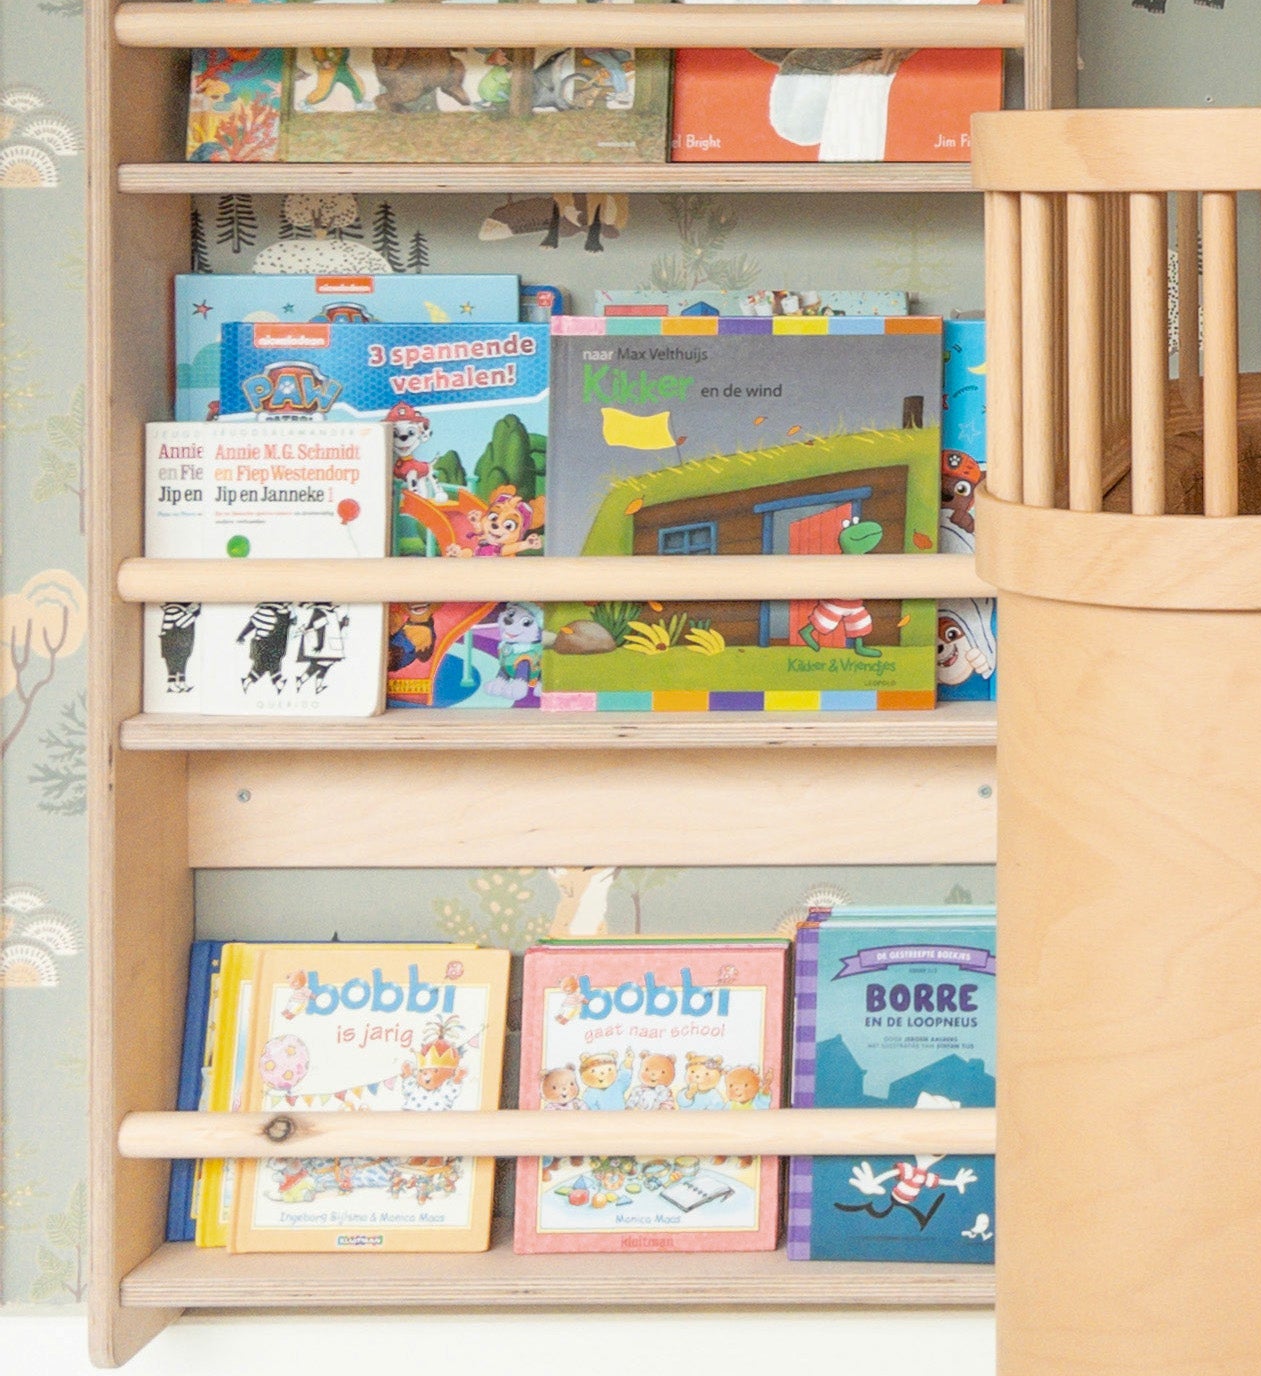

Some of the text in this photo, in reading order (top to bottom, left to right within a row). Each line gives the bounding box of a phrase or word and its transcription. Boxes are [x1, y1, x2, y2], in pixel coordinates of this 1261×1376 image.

[686, 134, 721, 151] Bright
[934, 134, 957, 149] Jim
[369, 333, 535, 367] 3 spannende
[582, 347, 708, 363] naar Max Velthuijs
[391, 364, 516, 392] verhalen!
[582, 363, 782, 405] Kikker en de wind
[242, 374, 343, 413] PAW
[158, 443, 203, 459] Annie
[214, 443, 260, 460] Annie
[297, 443, 361, 460] Schmidt
[158, 467, 177, 481] en
[214, 465, 361, 485] en Fiep Westendorp
[158, 486, 203, 506] Jip en
[215, 486, 238, 506] Jip
[240, 489, 259, 502] en
[260, 486, 325, 503] Janneke
[305, 963, 456, 1015] bobbi
[579, 967, 730, 1020] bobbi
[866, 983, 979, 1012] BORRE
[865, 1016, 978, 1027] EN DE LOOPNEUS
[337, 1022, 414, 1048] is jarig
[584, 1021, 726, 1044] gaat naar school
